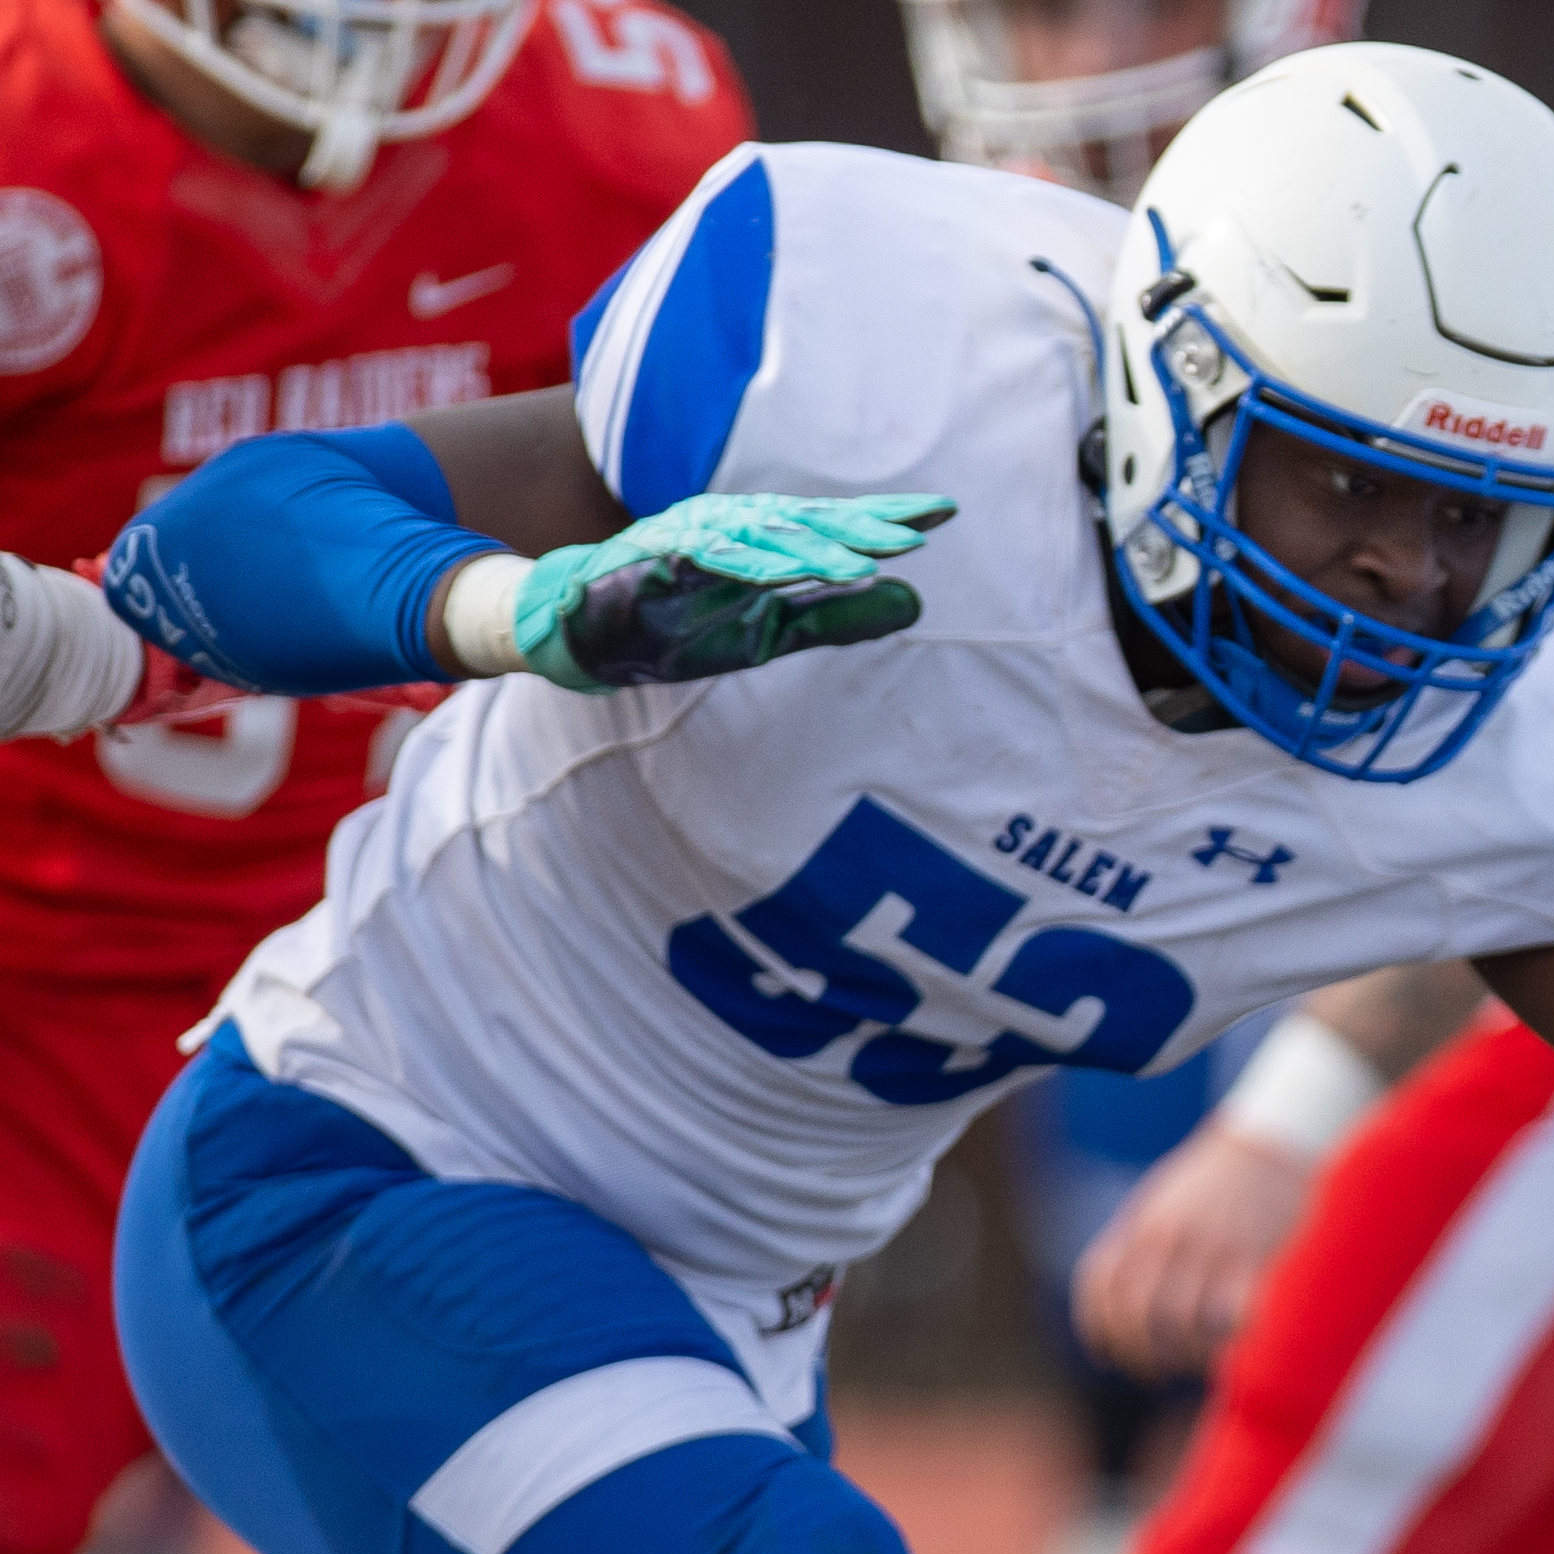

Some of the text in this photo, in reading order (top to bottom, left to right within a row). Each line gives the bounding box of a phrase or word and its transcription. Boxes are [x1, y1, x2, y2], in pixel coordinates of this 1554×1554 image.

[1424, 401, 1549, 450] Riddell
[992, 813, 1151, 913] SALEM
[668, 794, 1196, 1106] 53
